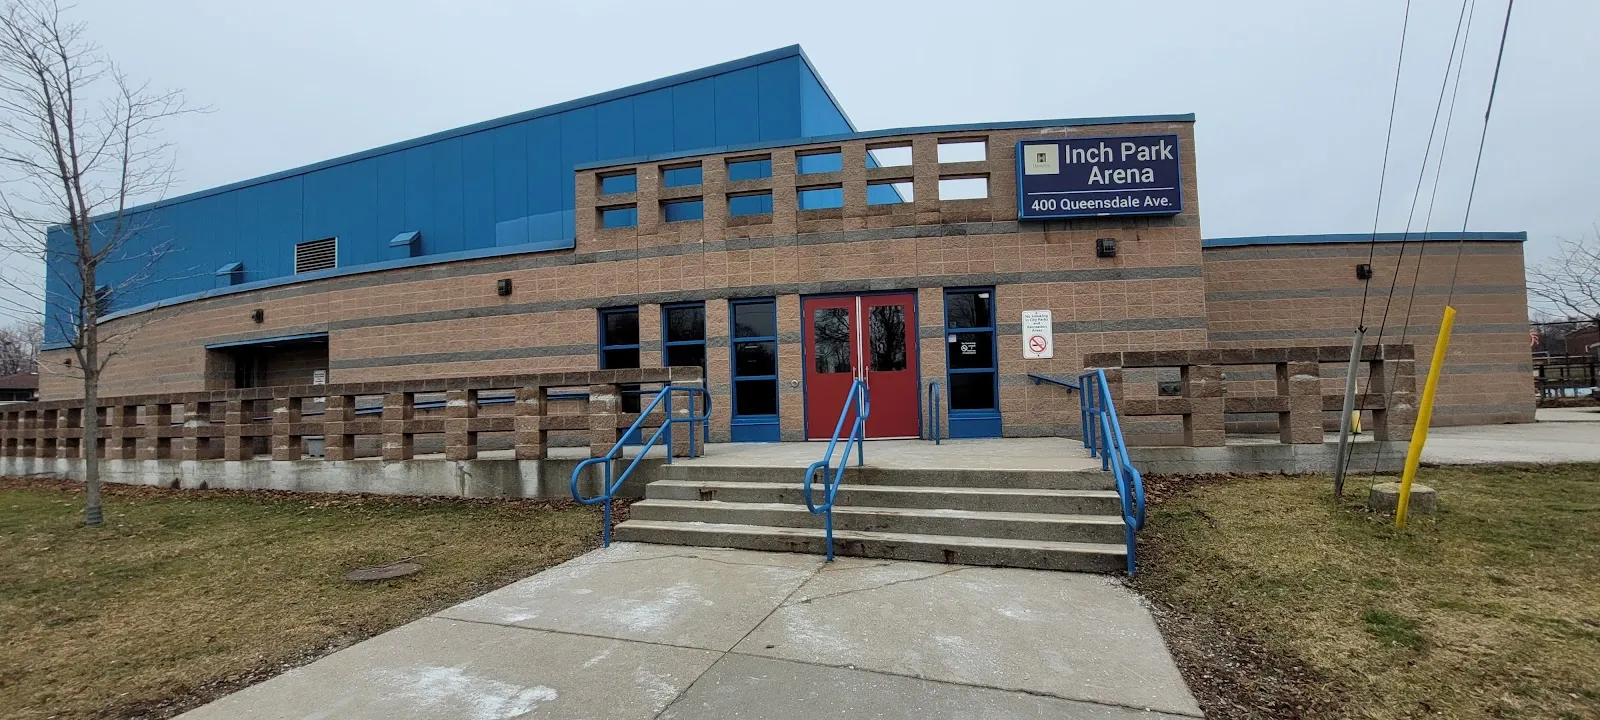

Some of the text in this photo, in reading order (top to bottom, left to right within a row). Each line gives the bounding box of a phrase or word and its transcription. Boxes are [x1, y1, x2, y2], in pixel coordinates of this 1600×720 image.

[1065, 140, 1173, 163] Inch Park
[1088, 165, 1154, 184] Arena
[1032, 195, 1172, 211] 400 Queensdale Ave.
